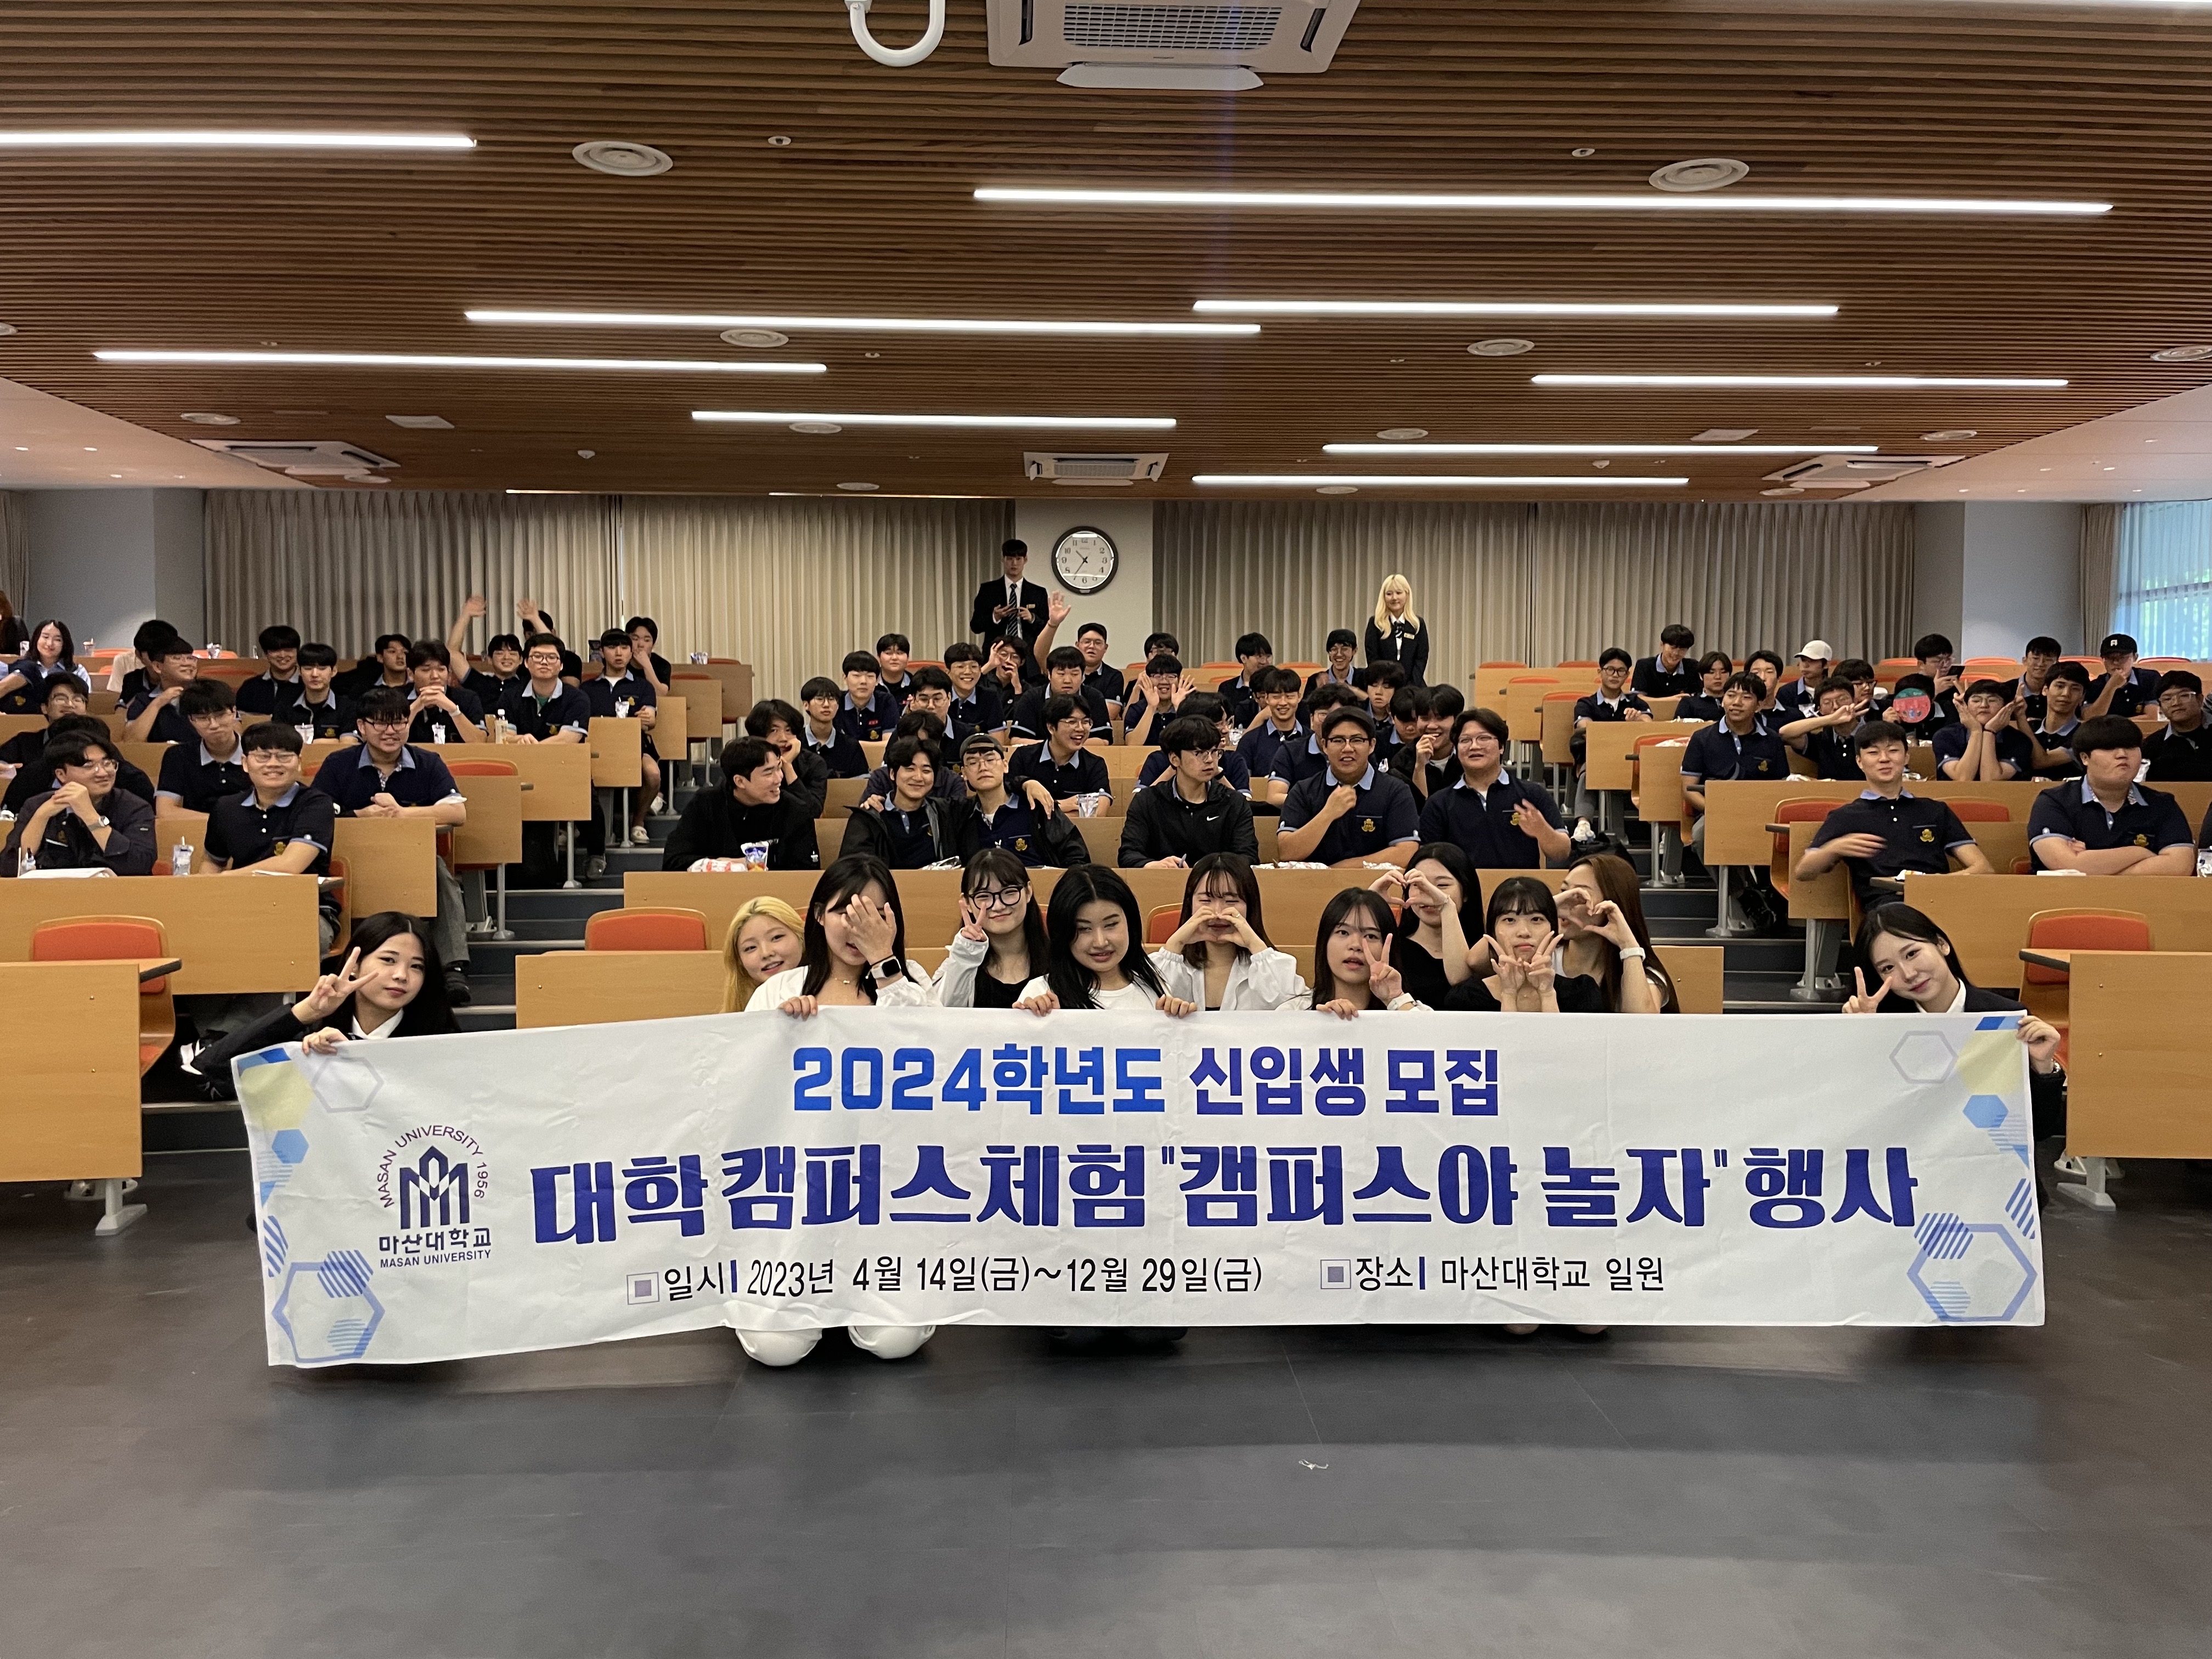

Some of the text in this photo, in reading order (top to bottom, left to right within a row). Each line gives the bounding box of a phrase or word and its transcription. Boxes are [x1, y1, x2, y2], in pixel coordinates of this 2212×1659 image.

[793, 1043, 1498, 1116] 2024학년도 신입생 모집
[377, 1125, 488, 1207] MASAN UNIVERSITY 1956
[1743, 1147, 1918, 1228] 행사
[379, 1228, 491, 1254] 마산대학교
[380, 1250, 491, 1268] MASAN UNIVERSITY
[747, 1259, 833, 1297] 2023년
[853, 1256, 902, 1291] 4월
[1142, 1257, 1262, 1292] 29일(금)
[1442, 1256, 1590, 1291] 마산대학교
[1606, 1257, 1664, 1291] 일원
